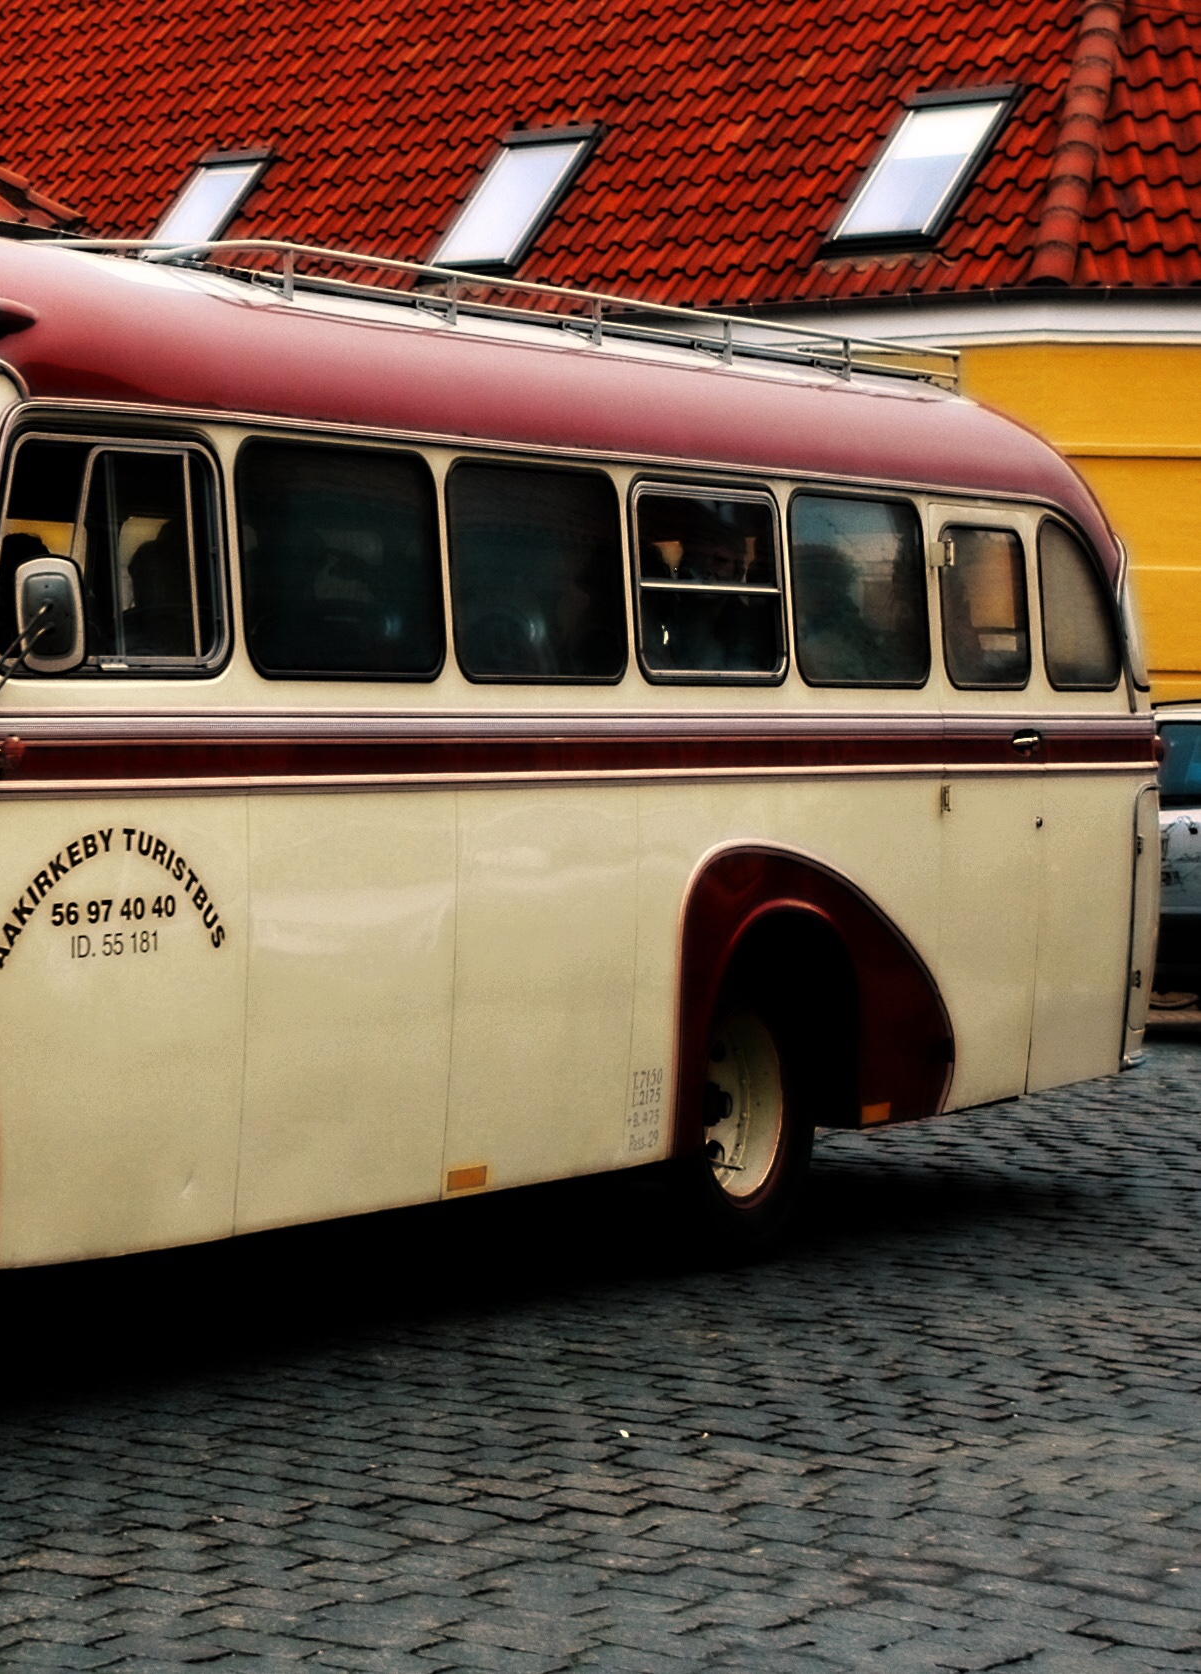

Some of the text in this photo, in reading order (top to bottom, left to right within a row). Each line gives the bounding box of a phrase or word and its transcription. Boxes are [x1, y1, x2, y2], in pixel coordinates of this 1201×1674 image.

[122, 828, 225, 949] TURISTBUS
[51, 895, 176, 927] 56 97 40 40
[71, 930, 158, 959] ID. 55 181
